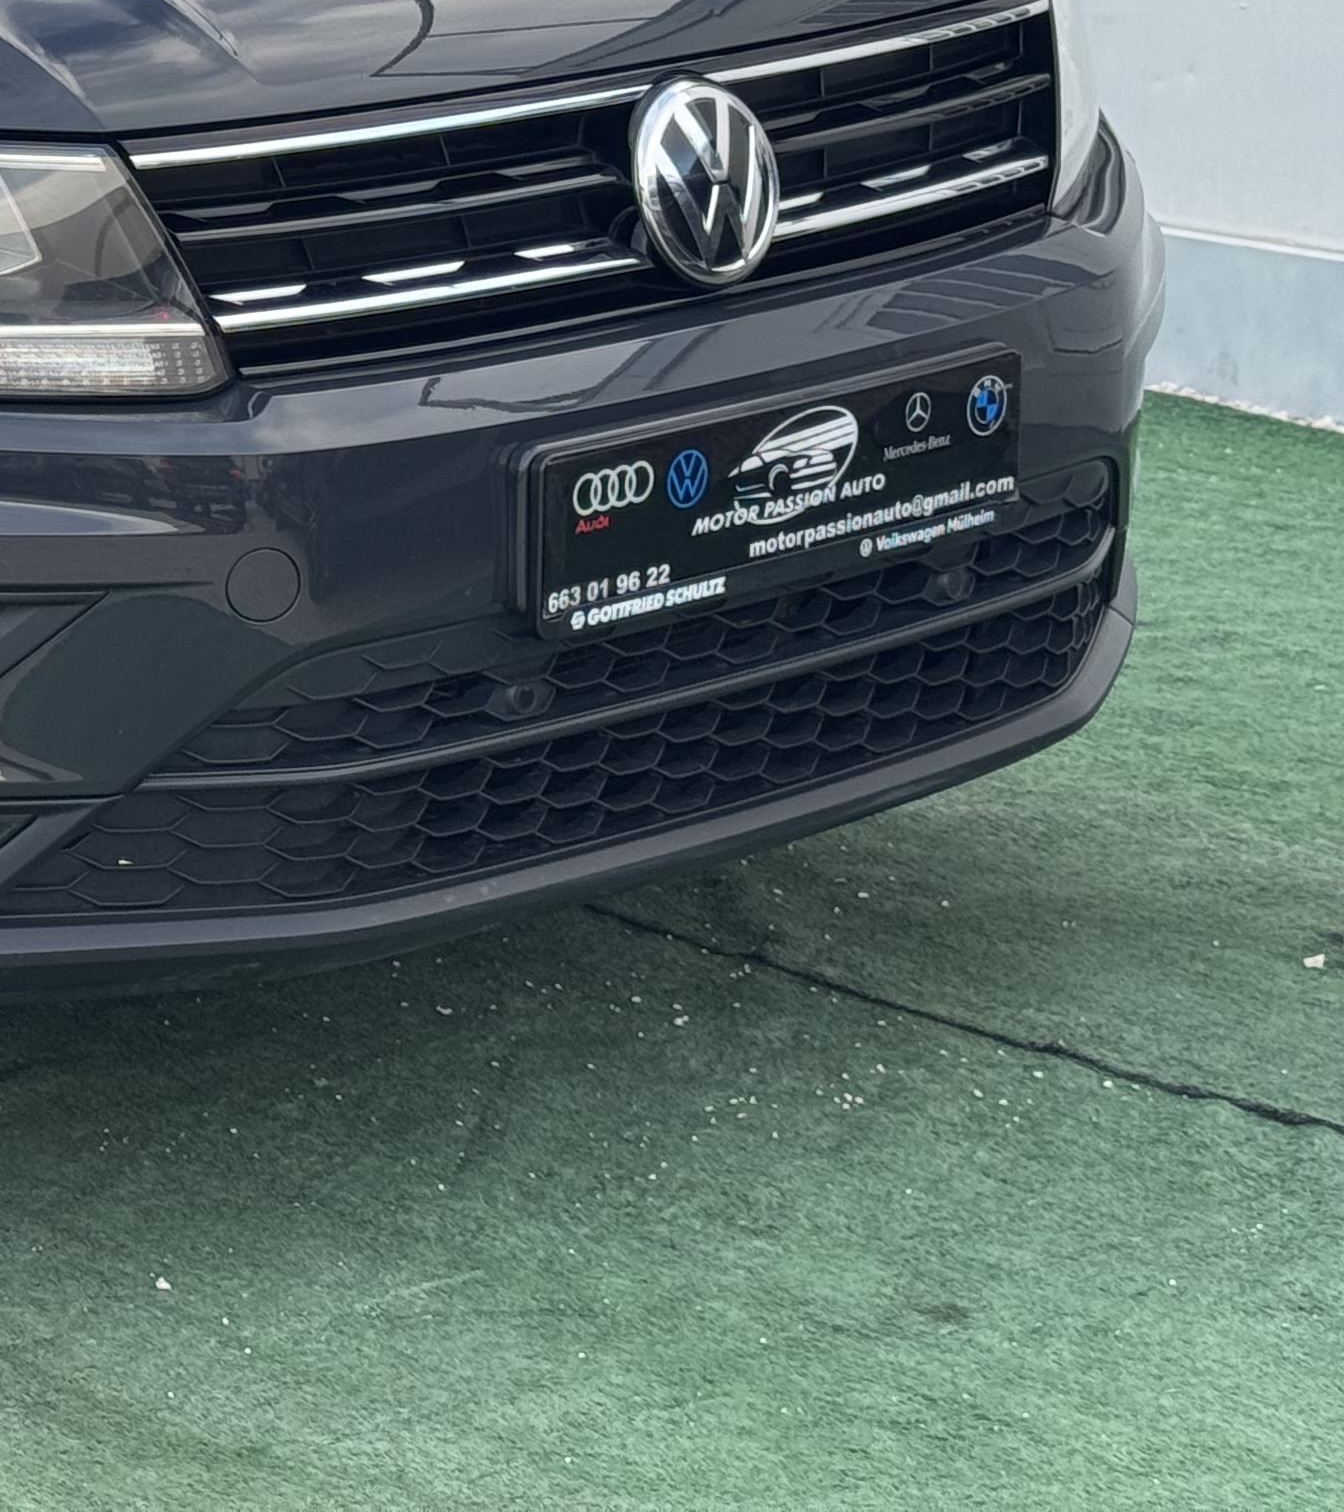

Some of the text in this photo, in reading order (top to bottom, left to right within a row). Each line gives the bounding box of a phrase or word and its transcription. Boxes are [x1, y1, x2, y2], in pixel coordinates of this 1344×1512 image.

[883, 434, 952, 462] Mercedes-Benz
[690, 473, 887, 537] MOTOR PASSION AUTO
[749, 475, 1015, 558] motorpassionauto@gmail.com
[876, 508, 996, 552] Volkswagen Mülheim
[548, 563, 672, 614] 663 01 96 22
[587, 576, 727, 626] GOTTFRIED SCHULTZ
